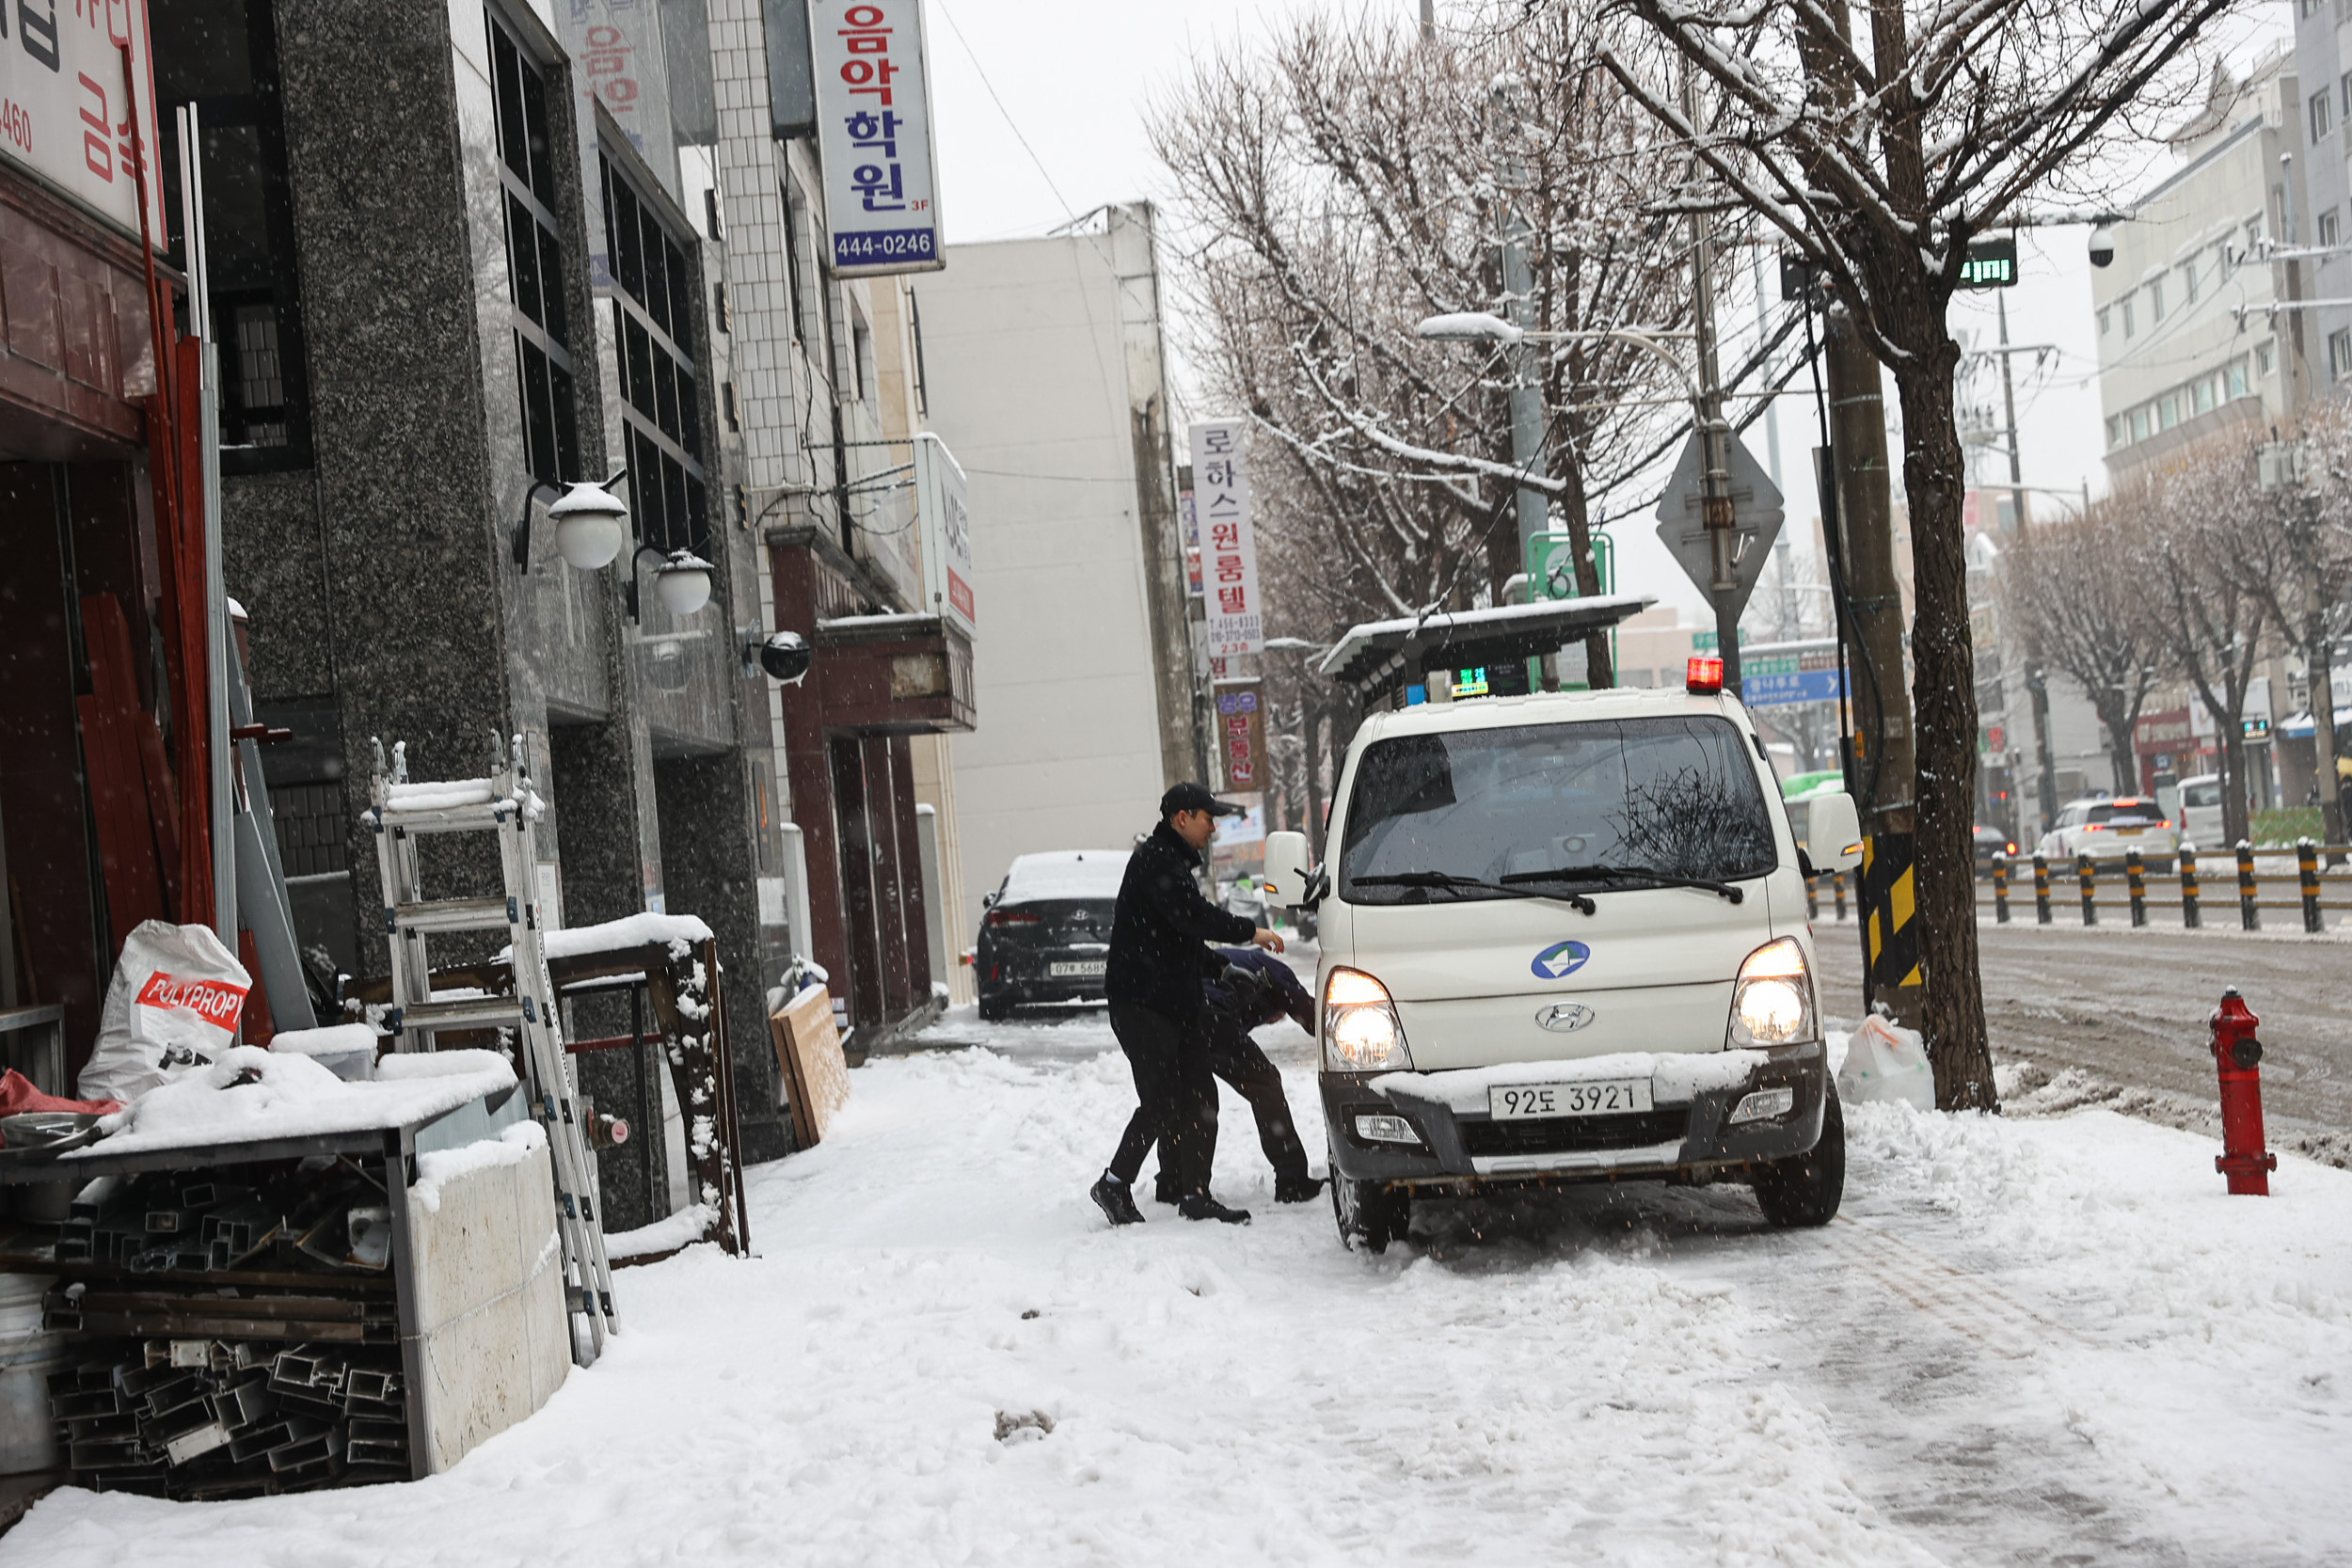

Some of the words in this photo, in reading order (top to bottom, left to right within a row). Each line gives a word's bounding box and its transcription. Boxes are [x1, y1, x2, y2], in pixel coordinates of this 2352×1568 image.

[912, 199, 929, 212] 3F
[837, 235, 930, 257] 444-0246
[1504, 1090, 1555, 1115] 92도
[1570, 1085, 1634, 1111] 3921
